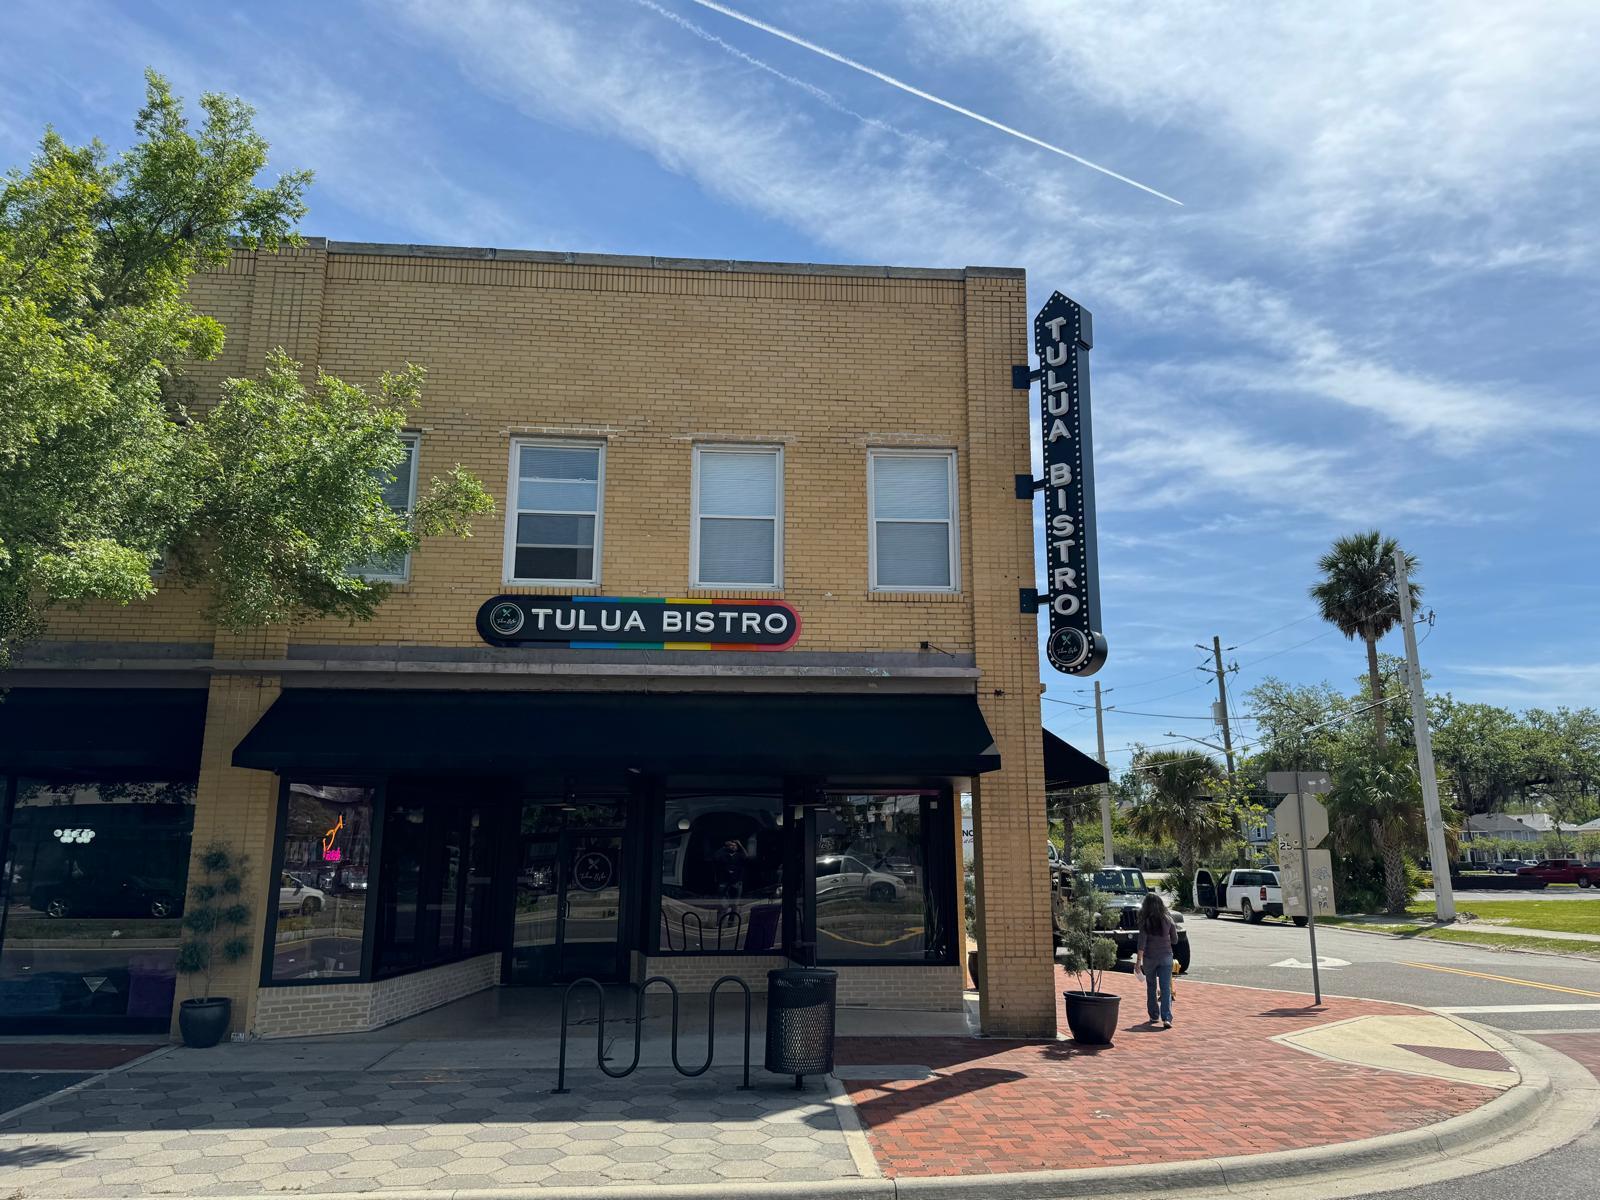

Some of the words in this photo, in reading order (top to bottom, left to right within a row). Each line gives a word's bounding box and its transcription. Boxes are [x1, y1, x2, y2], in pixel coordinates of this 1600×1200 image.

[1045, 316, 1071, 443] TULUA
[1050, 462, 1080, 616] BISTRO
[531, 608, 646, 632] TULUA
[662, 610, 788, 634] BISTRO
